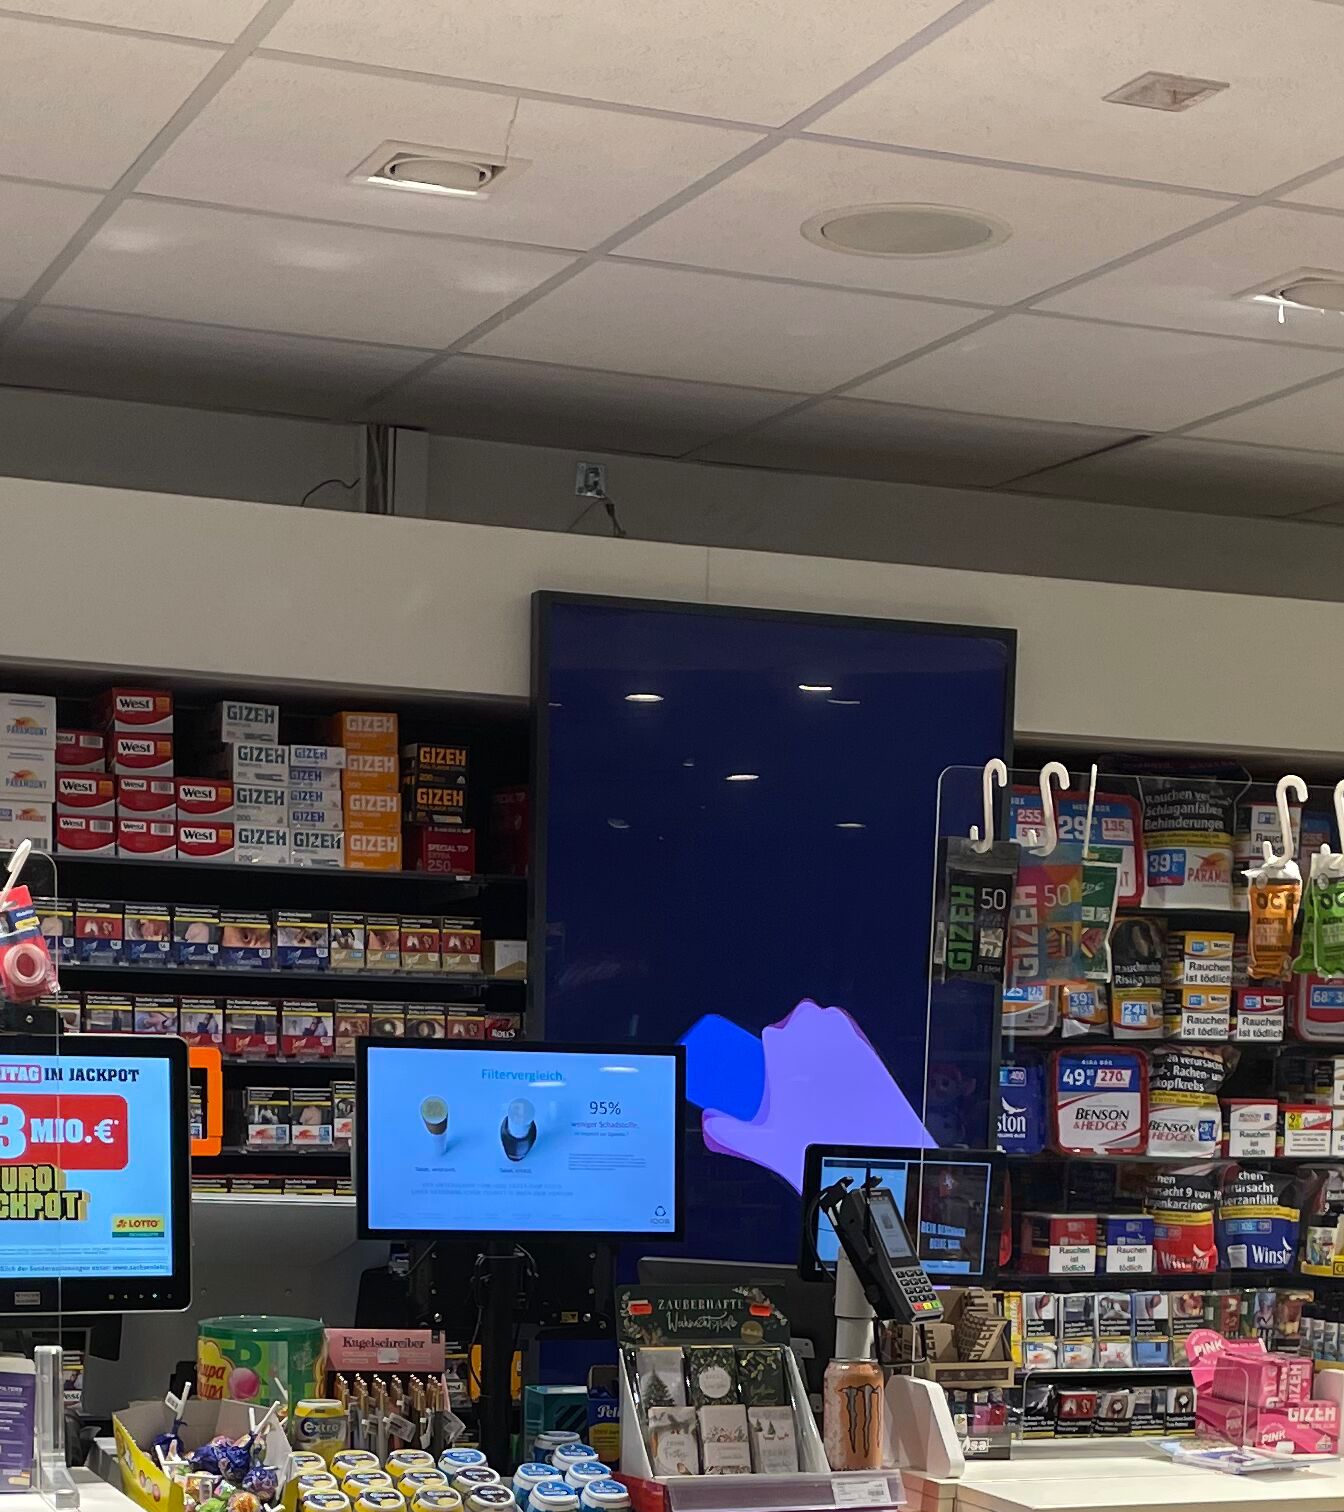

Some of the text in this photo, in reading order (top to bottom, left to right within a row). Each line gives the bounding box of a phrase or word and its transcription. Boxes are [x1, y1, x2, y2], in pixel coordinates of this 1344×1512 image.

[119, 698, 150, 710] West
[227, 704, 275, 725] GIZEH
[6, 725, 48, 737] PARAMOUNT
[346, 715, 394, 734] GIZEH
[120, 741, 151, 754] West
[238, 745, 286, 765] GIZEH
[419, 747, 467, 767] GIZEH
[347, 754, 395, 773] GIZEH
[6, 778, 47, 790] PARAMOUNT
[63, 780, 93, 792] West
[182, 787, 214, 800] West
[237, 787, 285, 806] GIZEH
[416, 788, 464, 807] GIZEH
[349, 794, 397, 813] GIZEH
[183, 828, 214, 842] West
[238, 828, 287, 846] GIZEH
[293, 831, 341, 849] GIZEH
[350, 834, 398, 852] GIZEH
[427, 859, 452, 872] 250
[980, 888, 1007, 910] 50
[1043, 883, 1072, 907] 50
[947, 884, 976, 971] GIZEH
[1189, 962, 1231, 973] Rauchen
[1187, 1015, 1228, 1026] Rauchen
[1242, 1016, 1283, 1027] Rauchen
[69, 1067, 140, 1082] JACKPOT
[481, 1068, 567, 1083] Filtervergleich.
[589, 1101, 622, 1115] 95%
[1074, 1107, 1130, 1121] BENSON
[1149, 1119, 1197, 1133] BENSON
[129, 1219, 159, 1228] LOTTO
[1058, 1246, 1090, 1256] Rauchen
[1116, 1246, 1148, 1256] Rauchen
[1061, 1264, 1086, 1273] tödlich
[1119, 1264, 1143, 1273] tödlich
[657, 1298, 744, 1311] ZAUBERHAFTE
[342, 1336, 425, 1350] Kugelschreiber
[1194, 1340, 1224, 1355] PINK
[1261, 1429, 1286, 1444] PINK
